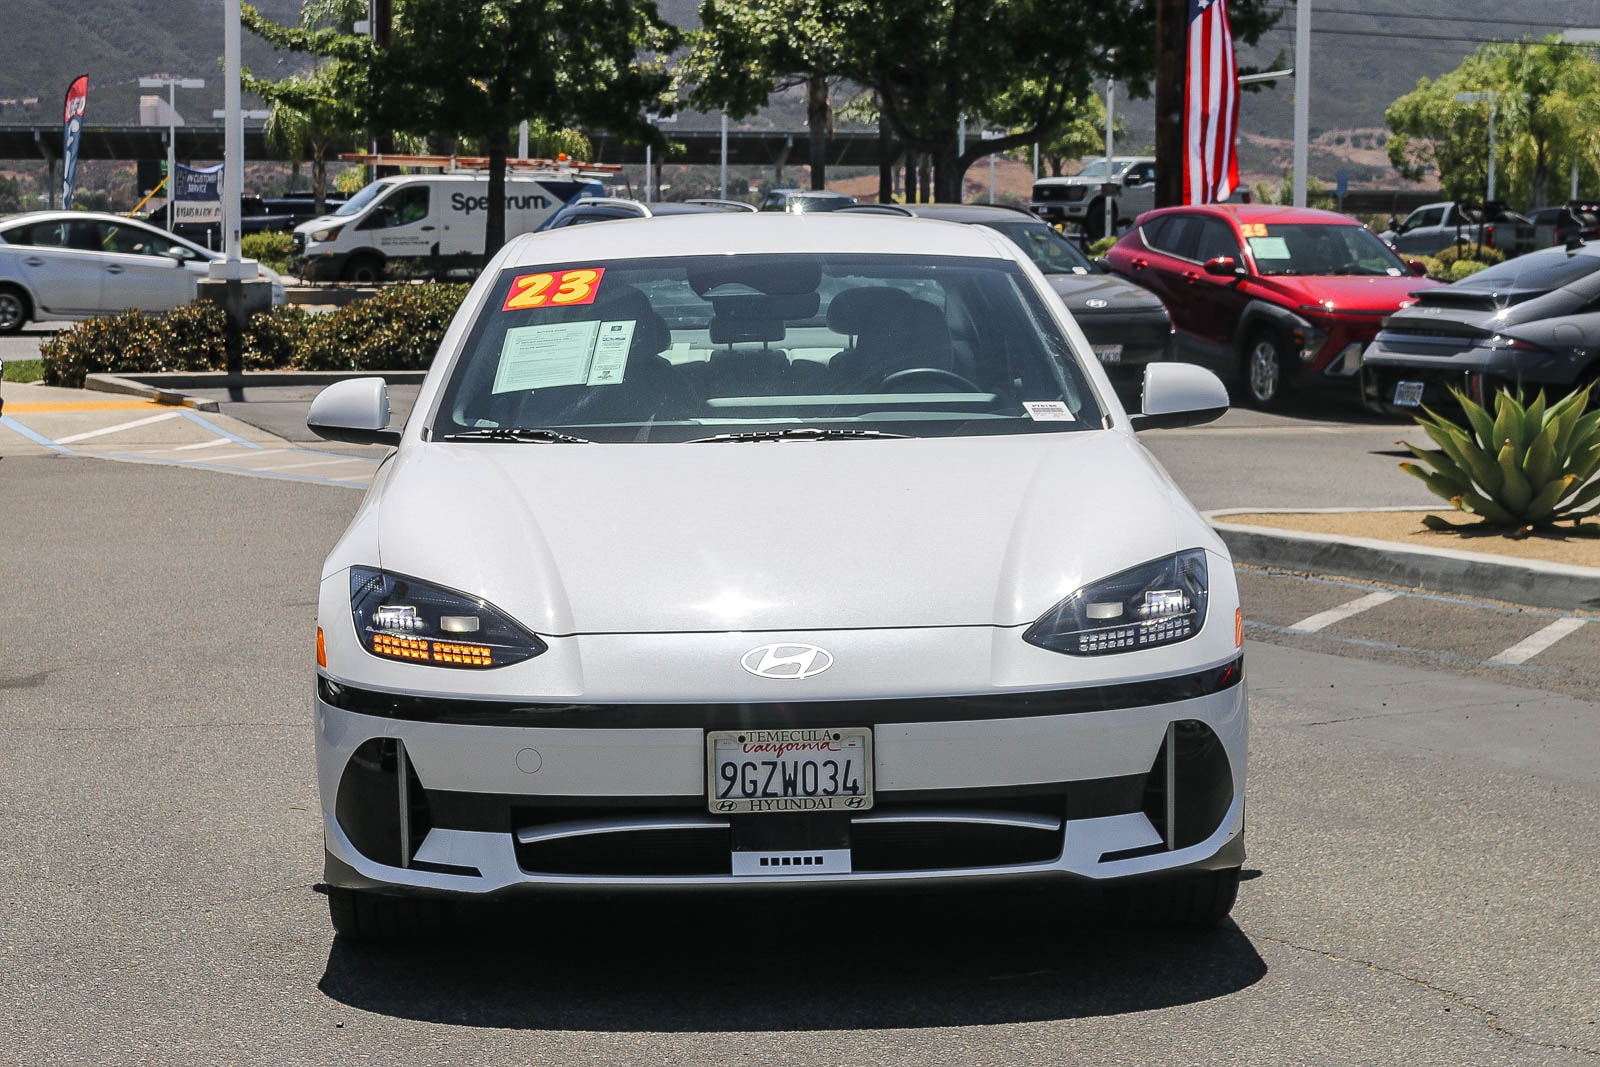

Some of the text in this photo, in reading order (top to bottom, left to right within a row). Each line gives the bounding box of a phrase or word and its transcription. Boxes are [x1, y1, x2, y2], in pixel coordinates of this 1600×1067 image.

[451, 192, 546, 215] Sperum
[507, 270, 598, 308] 23
[746, 729, 832, 743] TEMECULA
[720, 760, 860, 798] 9GZW034
[750, 798, 834, 811] HYUNDAI
